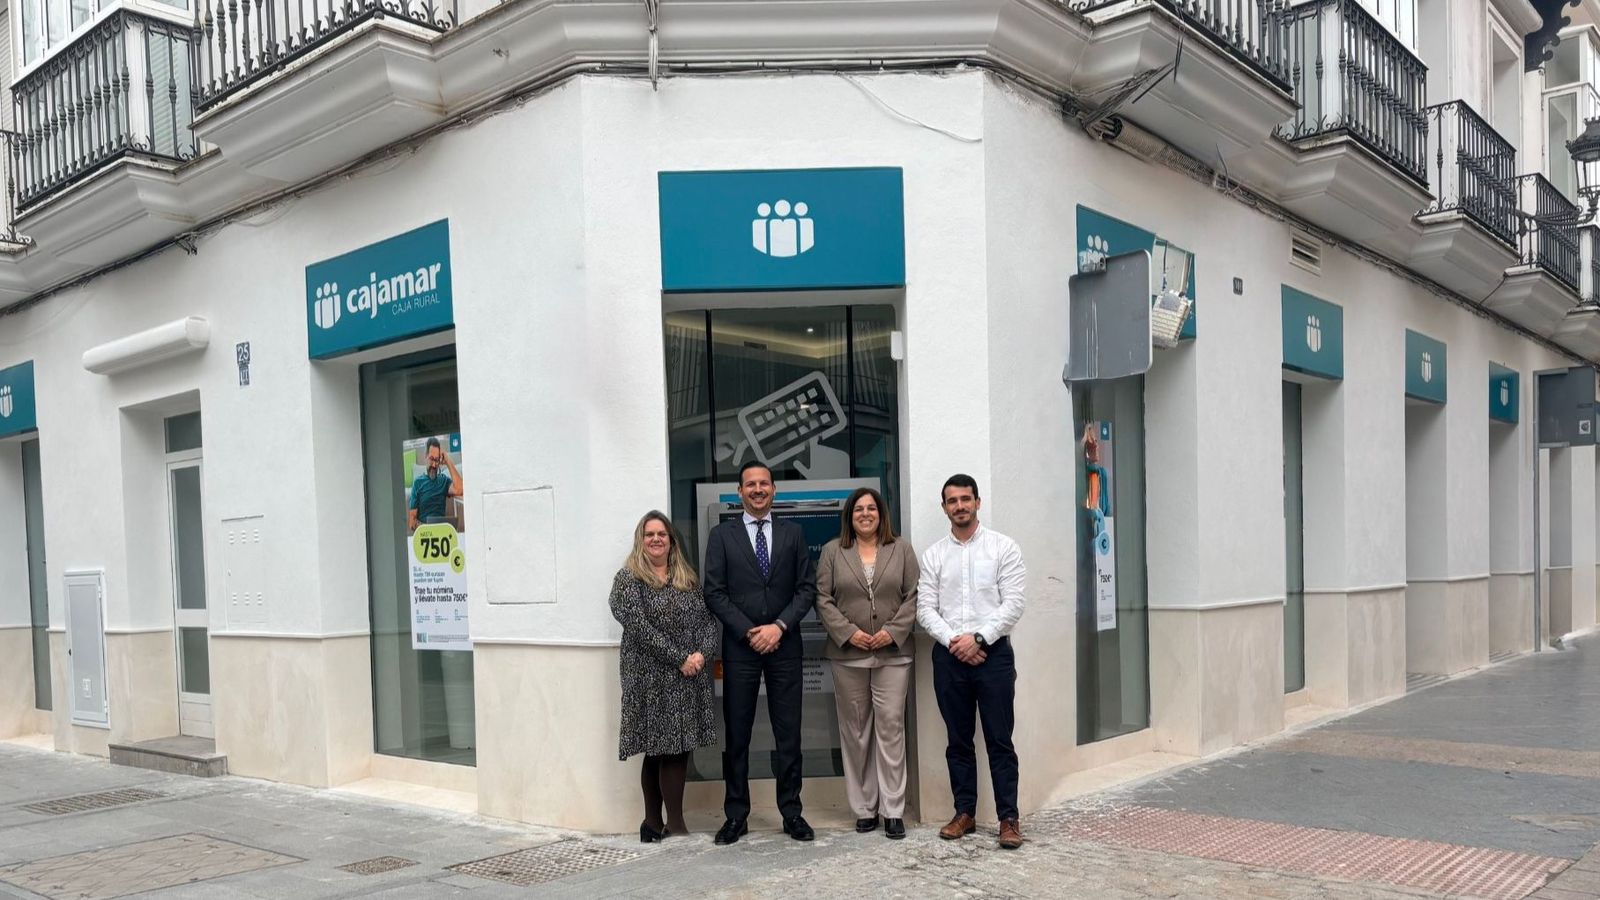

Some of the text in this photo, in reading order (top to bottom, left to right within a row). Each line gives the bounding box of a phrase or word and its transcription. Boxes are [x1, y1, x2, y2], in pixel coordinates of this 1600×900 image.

[346, 262, 441, 318] cajamar
[391, 294, 440, 316] CAJA RURAL
[237, 344, 250, 361] 25
[454, 556, 461, 567] €
